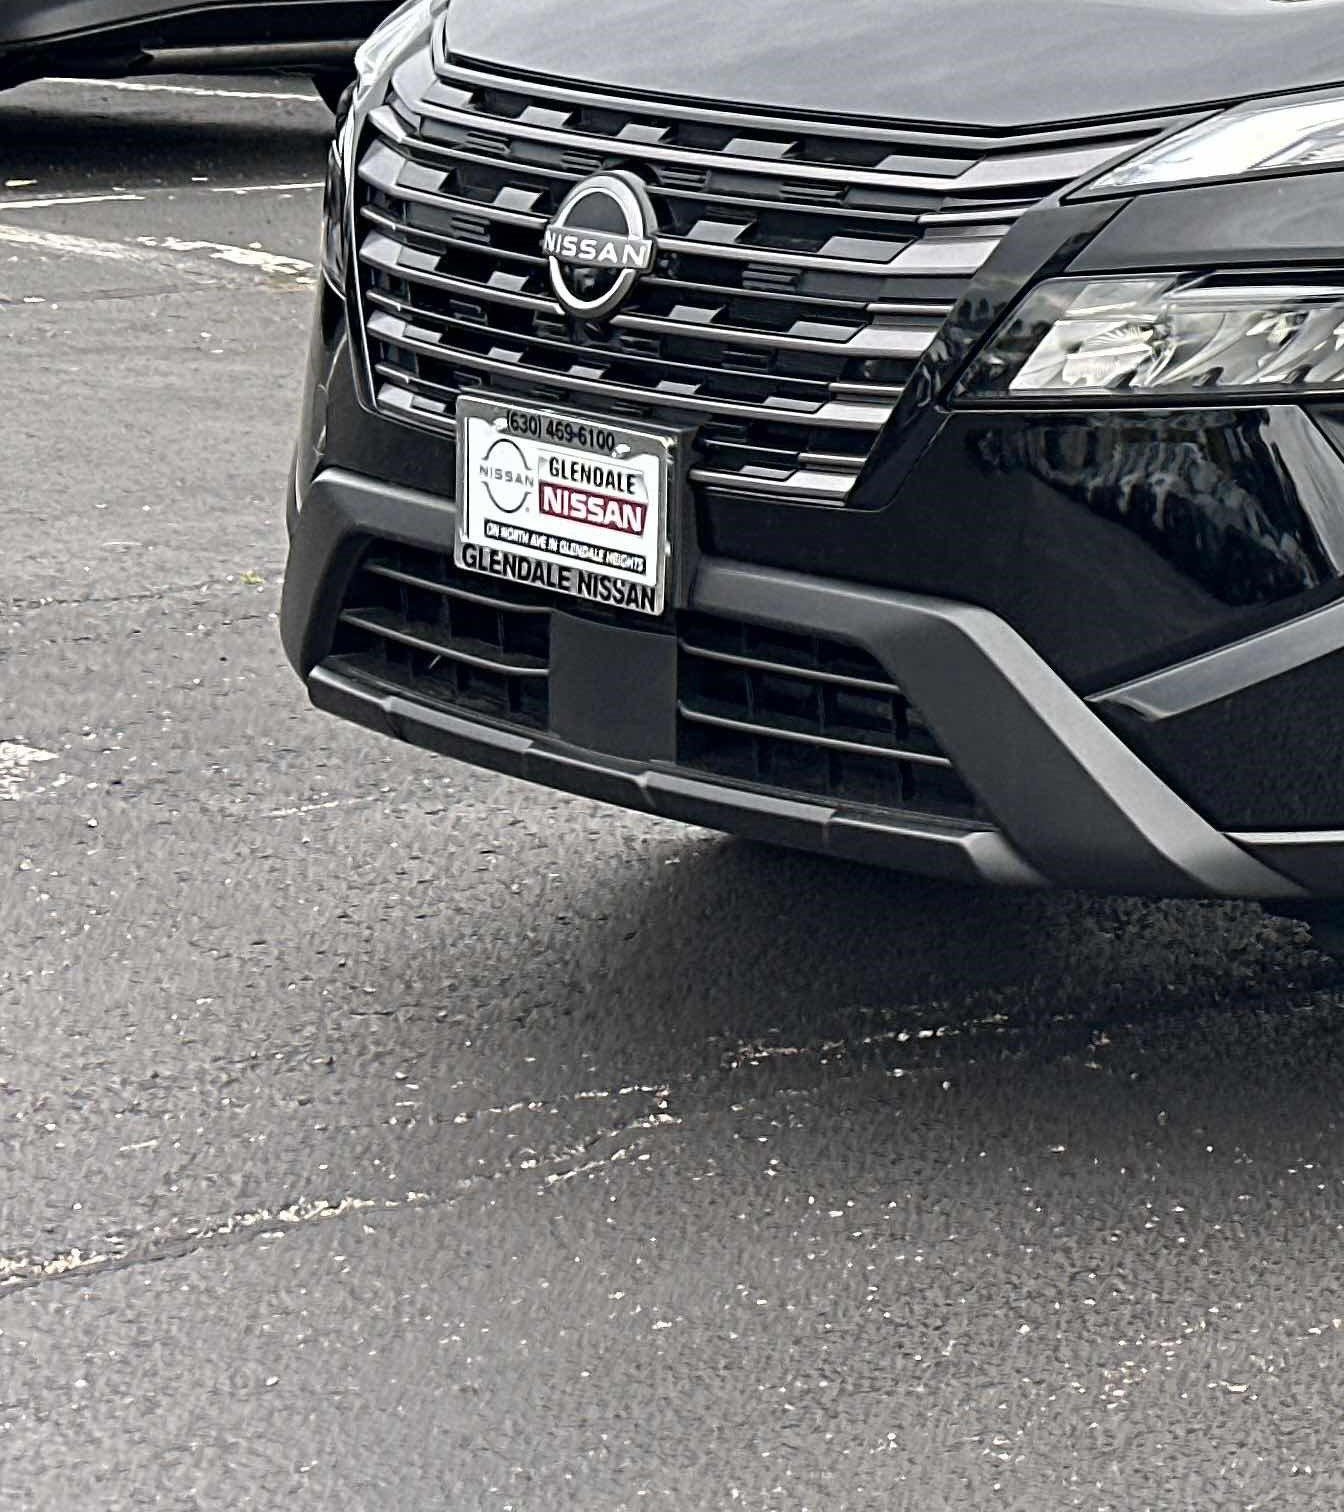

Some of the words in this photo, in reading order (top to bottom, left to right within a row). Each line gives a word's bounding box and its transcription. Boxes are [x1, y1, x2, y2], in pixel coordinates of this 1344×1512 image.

[543, 231, 648, 267] NISSAN
[506, 410, 542, 438] (630)
[546, 421, 616, 452] 469-6100
[479, 465, 535, 487] NISSAN
[549, 456, 636, 494] GLENDALE
[542, 486, 643, 532] NISSAN
[486, 522, 500, 537] ON
[502, 525, 529, 545] NORTH
[530, 533, 547, 549] AVE
[548, 537, 558, 552] IN
[559, 540, 605, 562] GLENDALE
[605, 551, 645, 572] HEIGHTS
[461, 543, 572, 593] GLENDALE
[577, 573, 656, 613] NISSAN
